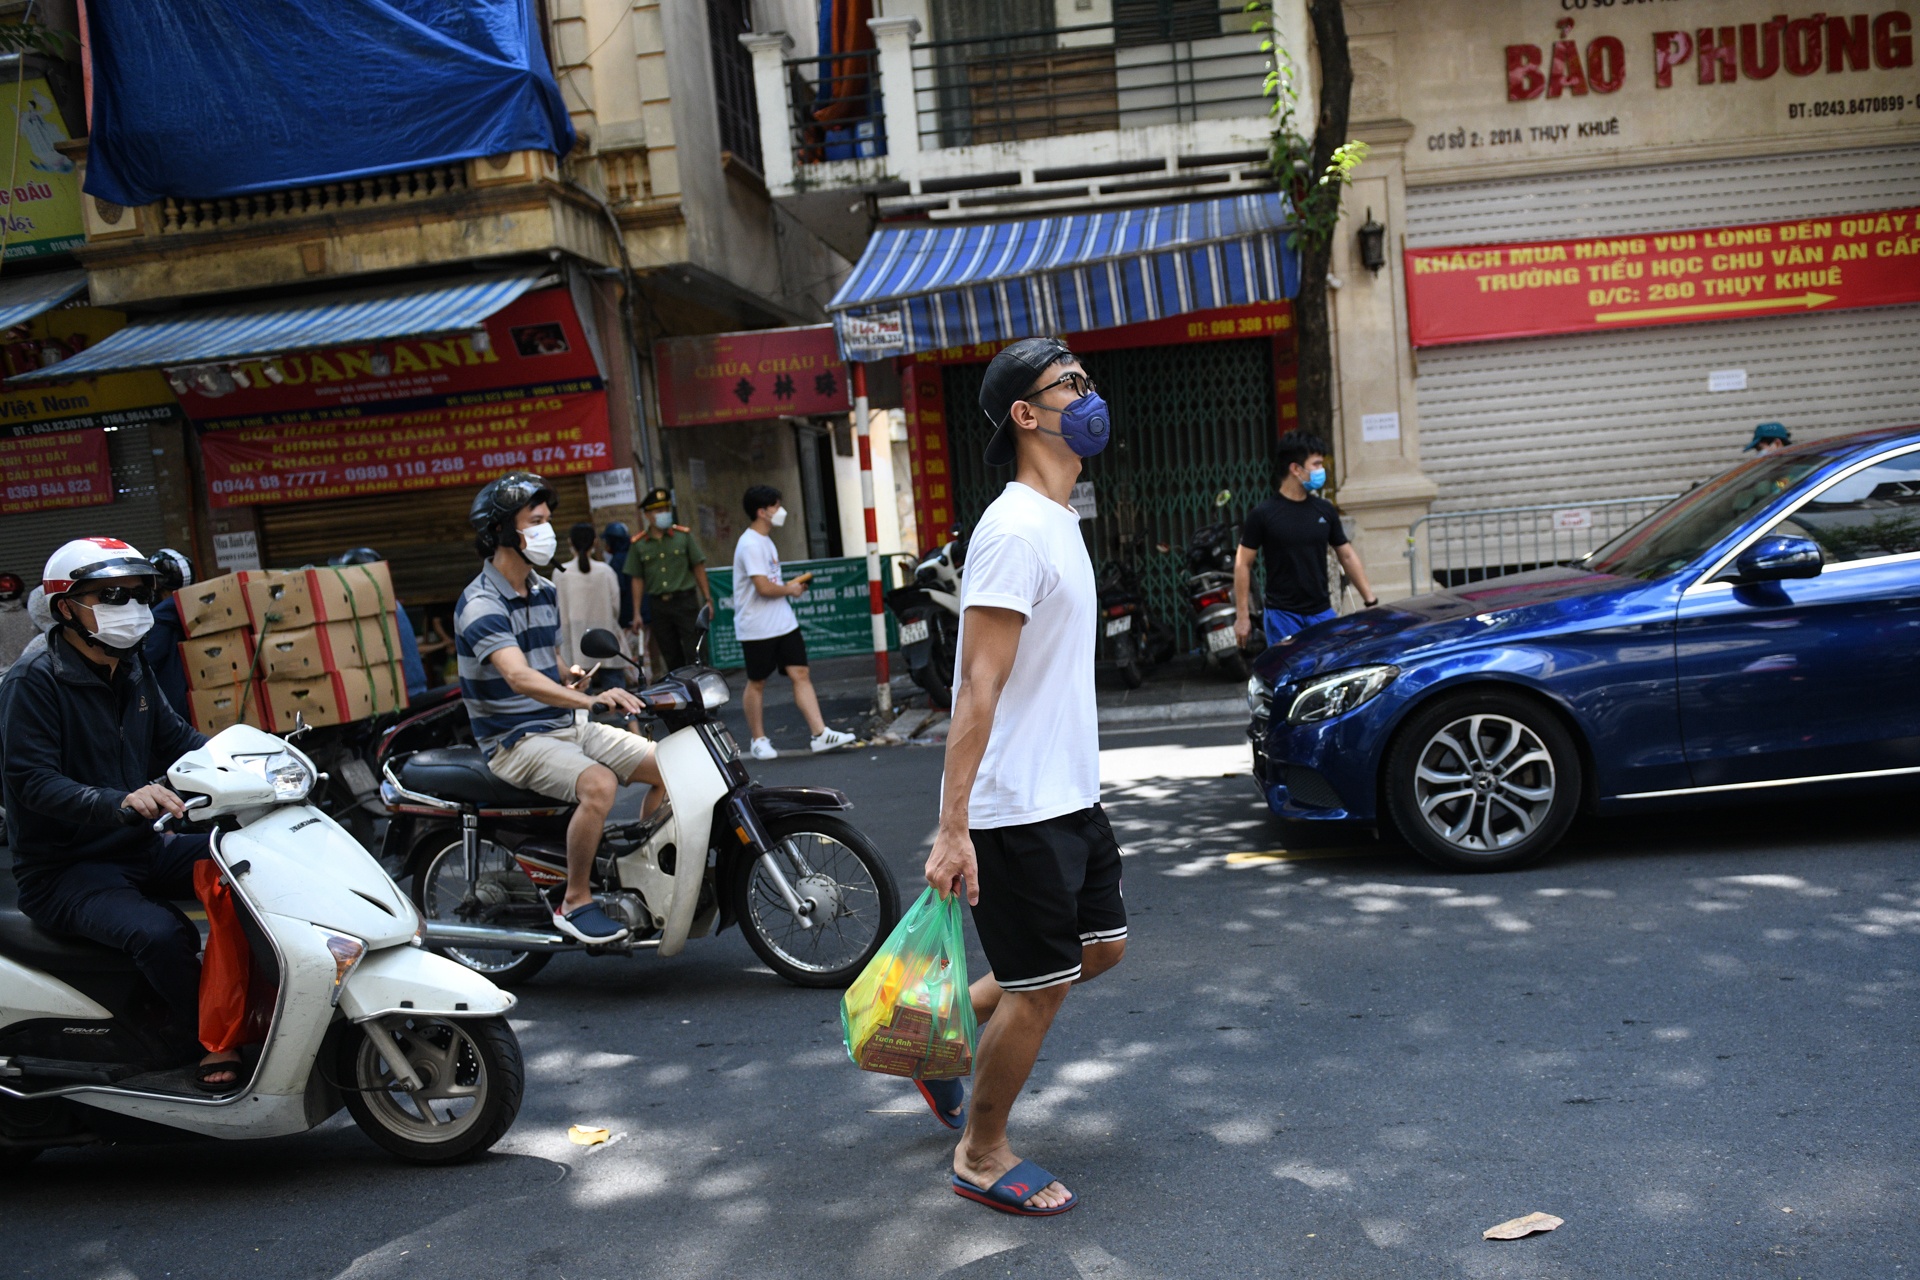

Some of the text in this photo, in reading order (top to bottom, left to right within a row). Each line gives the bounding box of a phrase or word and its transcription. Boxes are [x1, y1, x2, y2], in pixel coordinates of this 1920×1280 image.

[1505, 11, 1914, 103] BẢO PHƯƠNG
[1490, 128, 1523, 146] 201A
[1529, 124, 1571, 144] THỤY
[1577, 116, 1620, 137] KHUÊ
[1414, 249, 1501, 275] KHÁCH
[1509, 245, 1568, 266] MUA
[1575, 238, 1647, 260] HÀNG
[1655, 234, 1697, 252] VUI
[1703, 228, 1773, 249] LÒNG
[1779, 220, 1832, 242] ĐẾN
[1476, 267, 1581, 293] TRƯỜNG
[1587, 257, 1644, 283] TIỂU
[1652, 257, 1704, 279] HỌC
[1711, 251, 1764, 272] CHU
[1771, 245, 1824, 267] VĂN
[1831, 242, 1868, 261] AN
[1587, 265, 1843, 307] Đ/C: 260 THỤY KHUÊ
[394, 336, 500, 374] ANH
[0, 395, 90, 420] Việt Nam
[401, 411, 442, 427] ANH
[464, 436, 499, 452] XIN
[33, 467, 54, 479] XIN
[212, 477, 255, 495] 0944
[258, 474, 280, 490] 98
[283, 470, 328, 488] 7777
[344, 464, 389, 482] 0989
[394, 460, 427, 478] 110
[431, 456, 464, 474] 268
[481, 451, 528, 469] 0984
[532, 446, 567, 463] 874
[569, 442, 607, 460] 752
[7, 479, 92, 500] 0369 644 823
[896, 1038, 912, 1047] Anh
